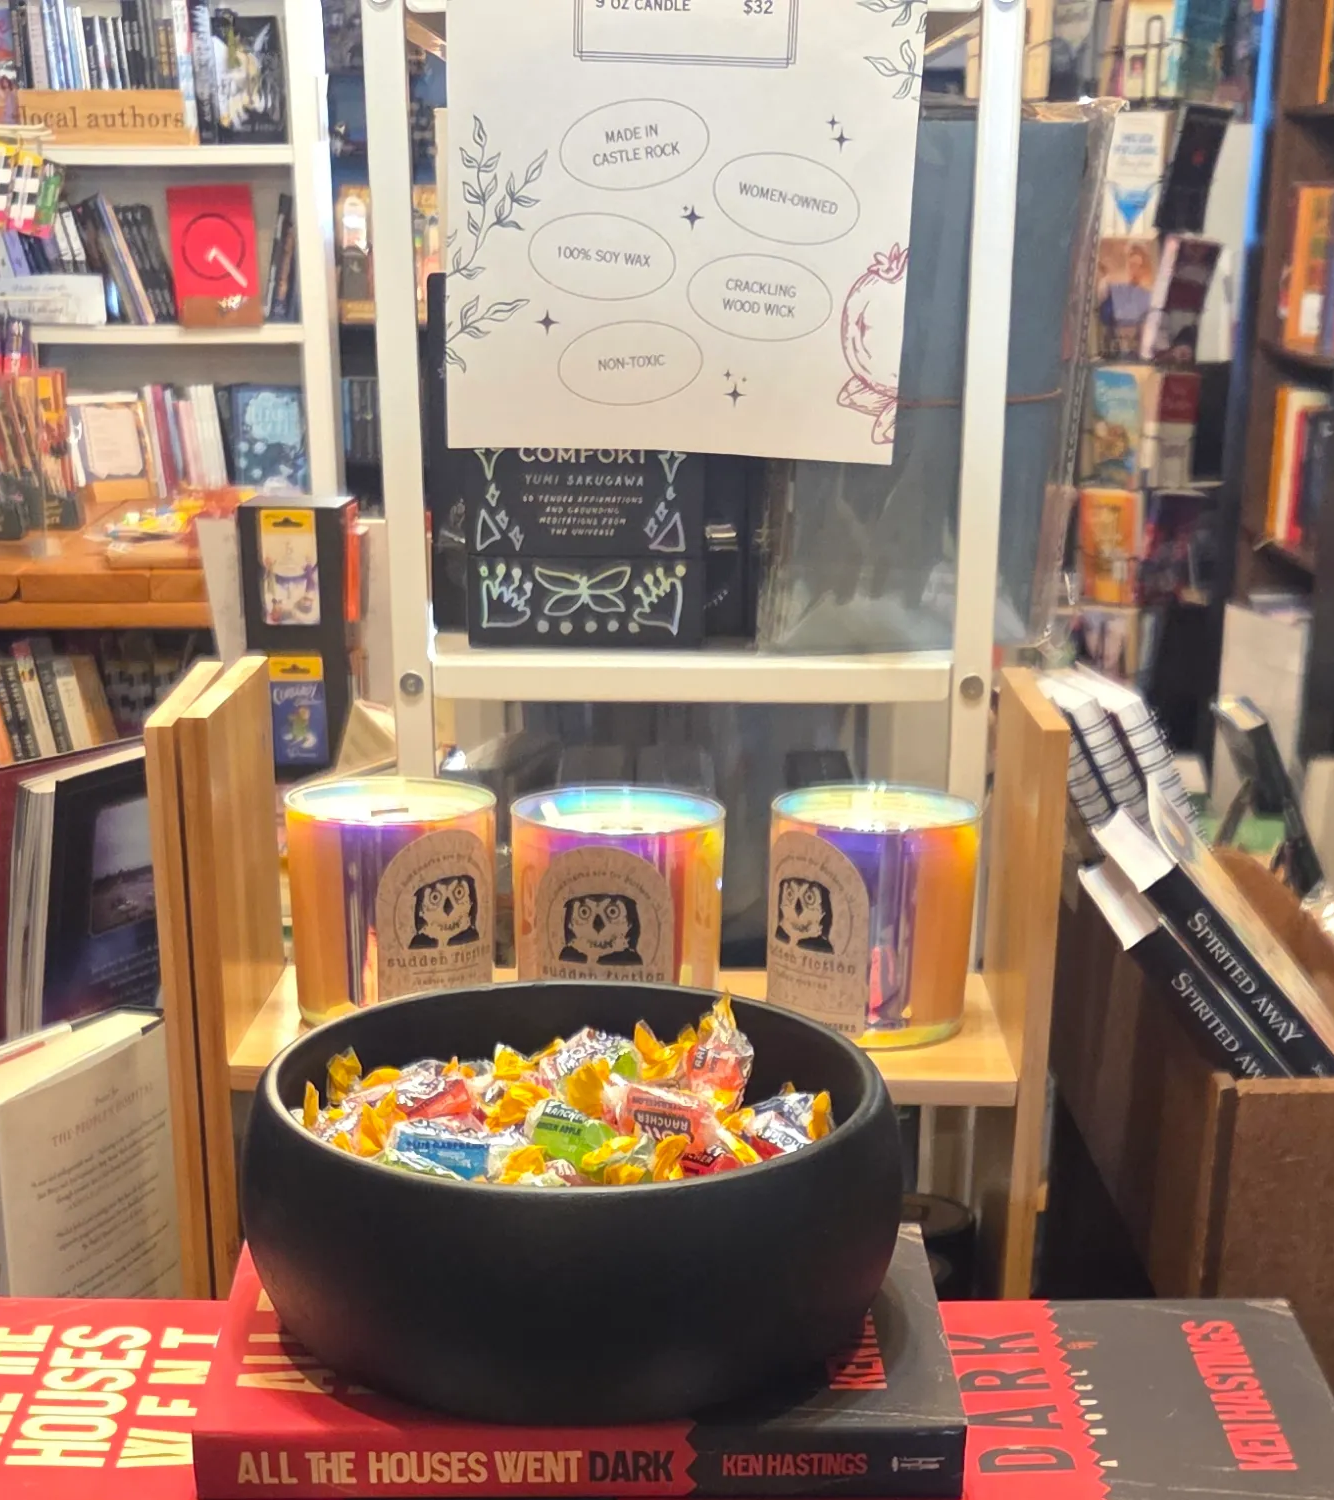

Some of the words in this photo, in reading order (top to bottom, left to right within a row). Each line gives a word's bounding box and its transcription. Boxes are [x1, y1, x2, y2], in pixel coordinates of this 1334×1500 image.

[610, 0, 630, 10] OZ
[633, 0, 692, 13] CANDLE
[743, 0, 774, 16] $32
[21, 105, 79, 129] local
[86, 105, 185, 130] authors
[605, 125, 643, 144] MADE
[645, 123, 659, 139] IN
[592, 148, 642, 167] CASTLE
[644, 141, 681, 158] ROCK
[738, 181, 839, 216] WOMEN-OWNED
[556, 245, 592, 262] 100%
[595, 248, 621, 265] SOY
[623, 252, 652, 268] WAX
[725, 277, 797, 299] CRACKLING
[722, 298, 761, 315] WOOD
[763, 303, 796, 319] WICK
[597, 352, 666, 373] NON-TOXIC
[524, 474, 559, 487] YUMI
[566, 474, 644, 487] SAKUGAWA
[1251, 994, 1308, 1046] AWAY
